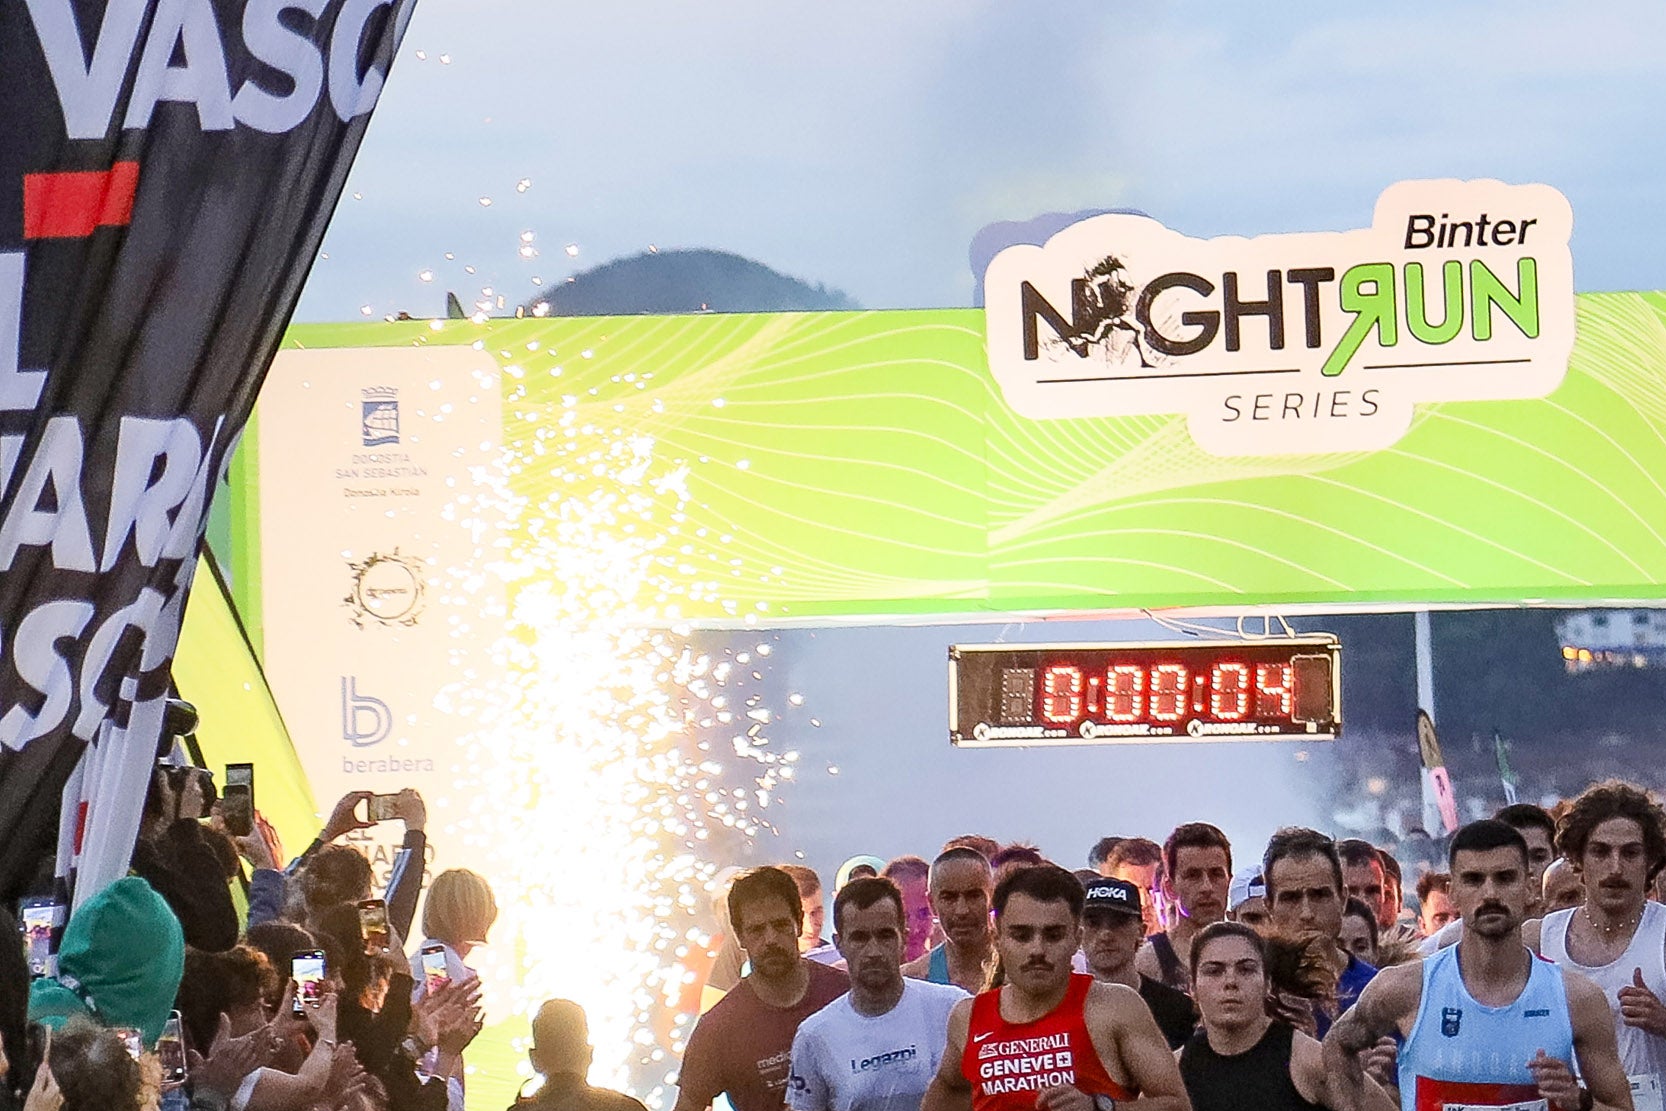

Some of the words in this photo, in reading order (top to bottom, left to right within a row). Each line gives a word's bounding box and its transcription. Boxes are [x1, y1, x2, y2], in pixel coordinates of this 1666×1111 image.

[1403, 213, 1538, 249] Binter
[1222, 389, 1380, 422] SERIES
[1042, 662, 1292, 722] 0:00:04
[342, 755, 435, 774] berabera
[1086, 886, 1127, 901] HOKA
[998, 1033, 1070, 1055] GENERALI
[980, 1054, 1053, 1078] GENÈVE
[981, 1071, 1075, 1096] MARATHON
